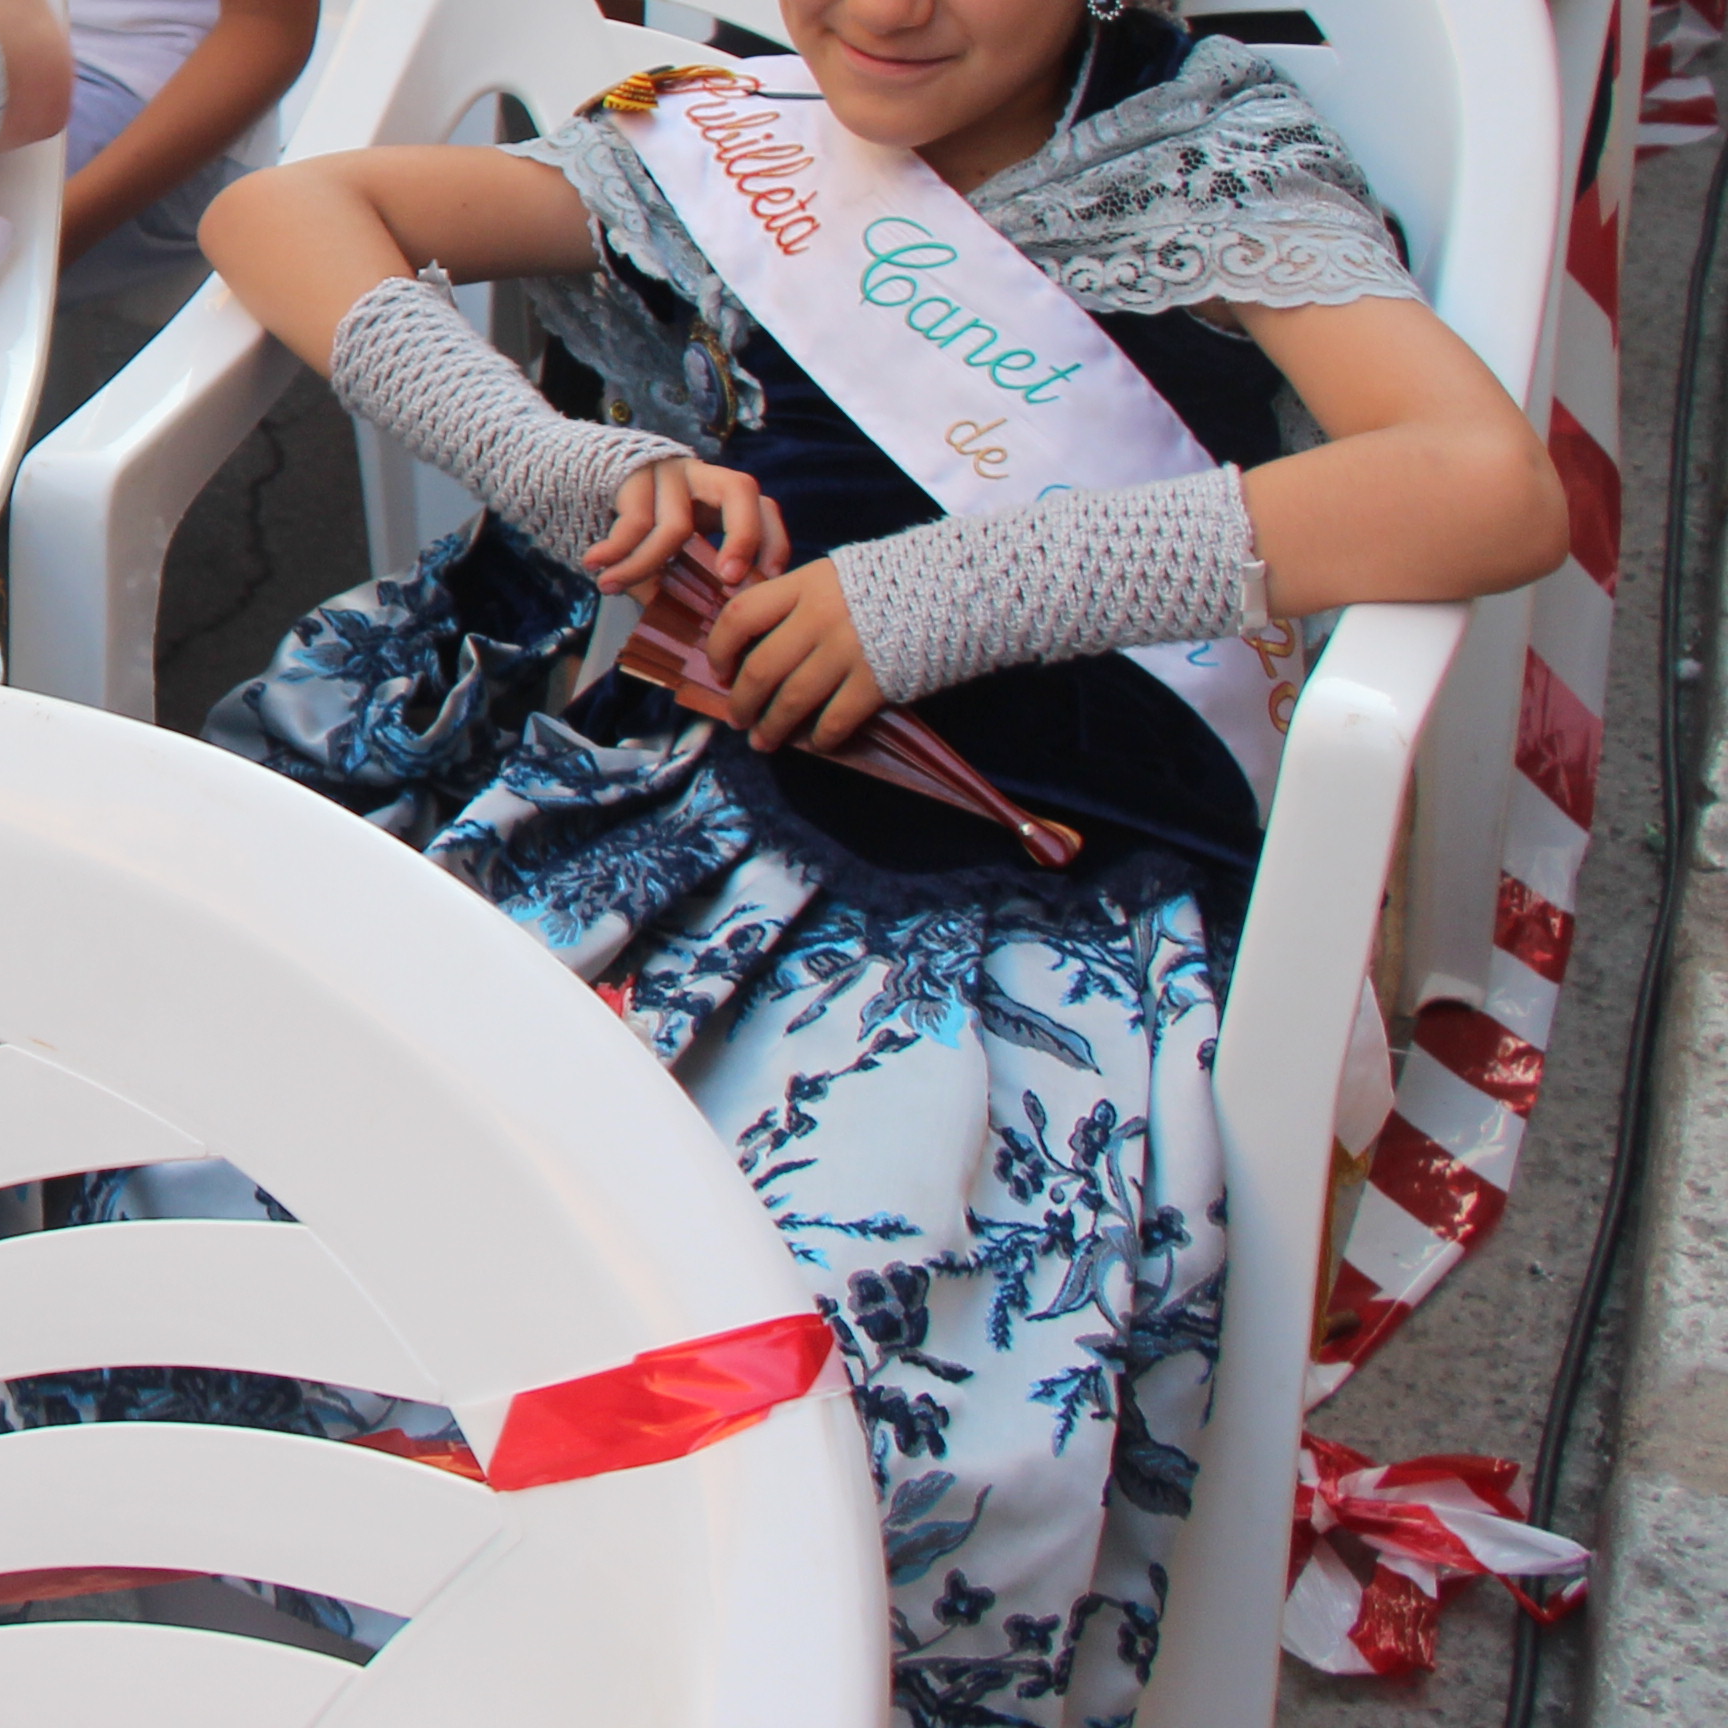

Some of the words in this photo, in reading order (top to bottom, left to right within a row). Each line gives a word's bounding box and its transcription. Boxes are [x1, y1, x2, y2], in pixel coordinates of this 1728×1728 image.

[659, 75, 821, 256] Pubilleta
[861, 216, 1083, 404] Canet
[944, 418, 1010, 480] de
